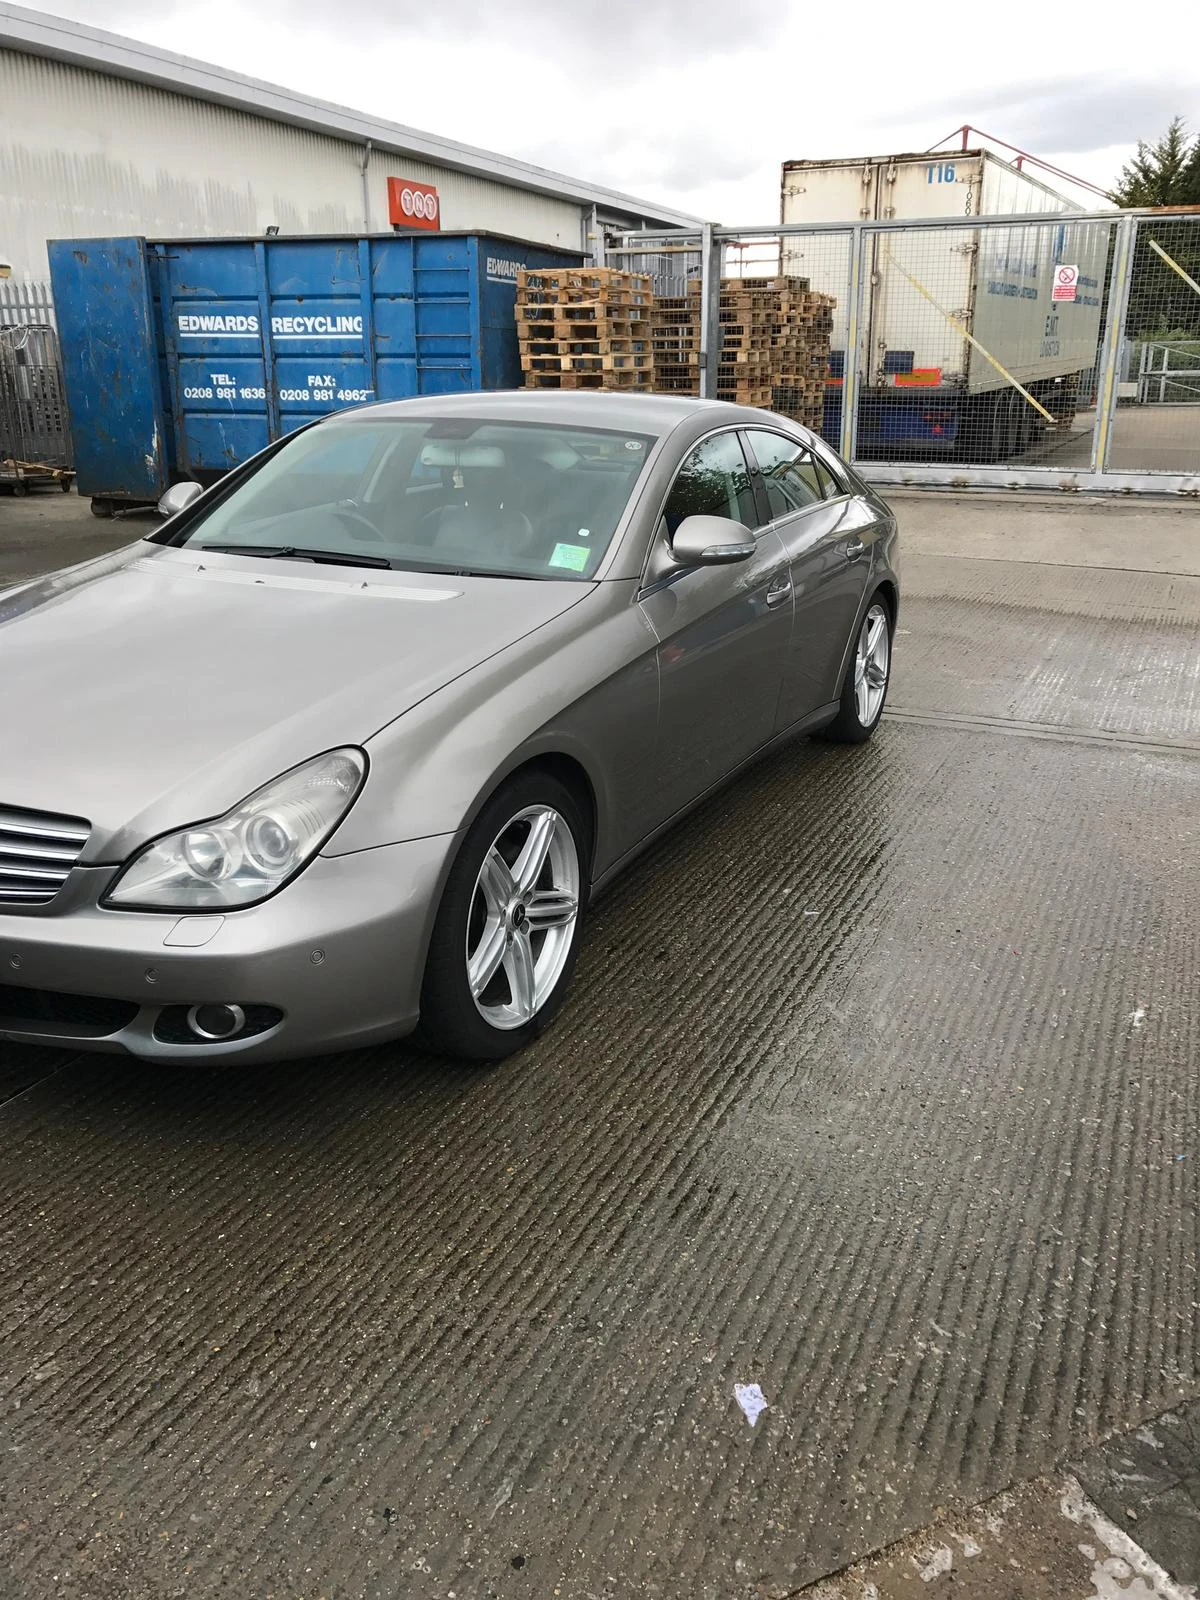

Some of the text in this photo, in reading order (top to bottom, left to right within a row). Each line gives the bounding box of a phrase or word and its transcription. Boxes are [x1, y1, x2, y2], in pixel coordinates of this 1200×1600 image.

[401, 188, 437, 220] TNT
[178, 315, 363, 332] EDWARDS RECYCLING
[210, 373, 236, 385] TEL:
[307, 375, 336, 386] FAX:
[184, 387, 266, 399] 0208 981 1636
[279, 389, 367, 400] 0208 981 4962
